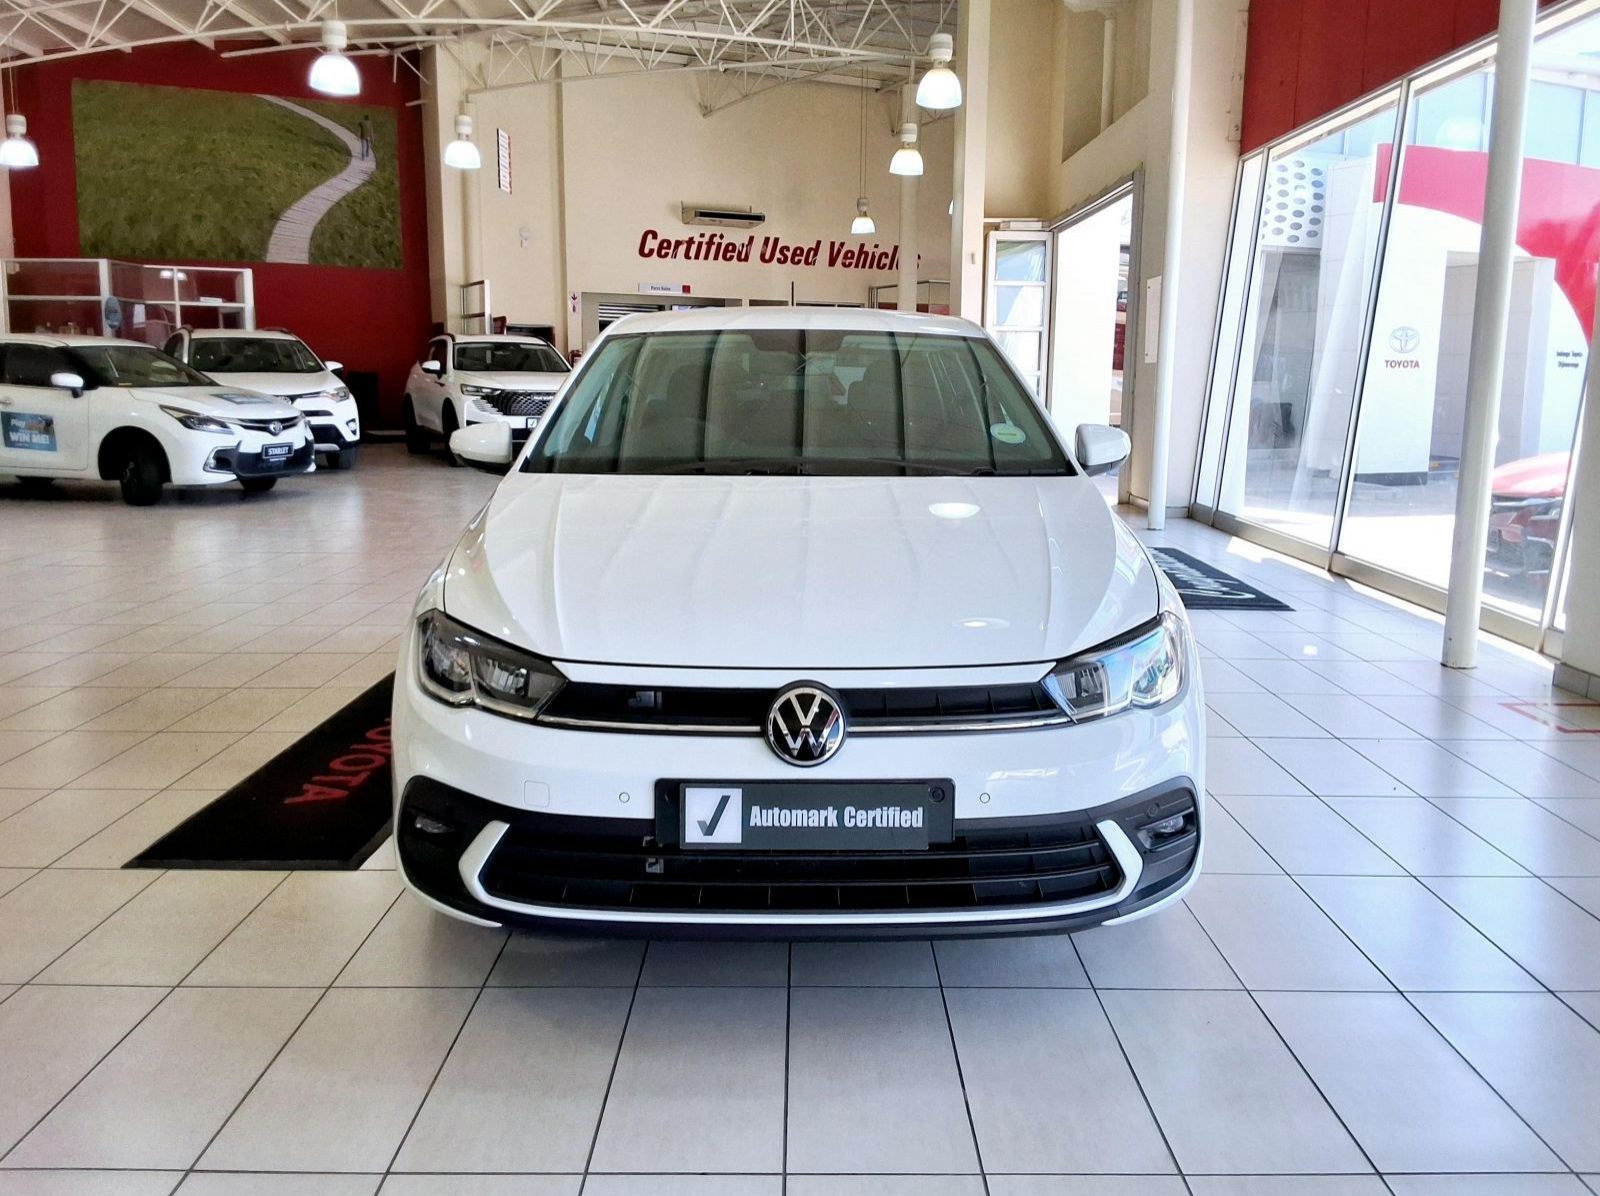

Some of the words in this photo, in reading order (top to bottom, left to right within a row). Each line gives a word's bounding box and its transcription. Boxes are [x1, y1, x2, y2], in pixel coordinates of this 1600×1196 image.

[638, 229, 754, 262] Certified
[759, 236, 822, 266] Used
[827, 240, 921, 271] Vehicl
[1384, 359, 1420, 369] TOYOTA
[283, 718, 392, 804] OYOTA
[750, 805, 839, 828] Automark
[843, 805, 924, 828] Certified
